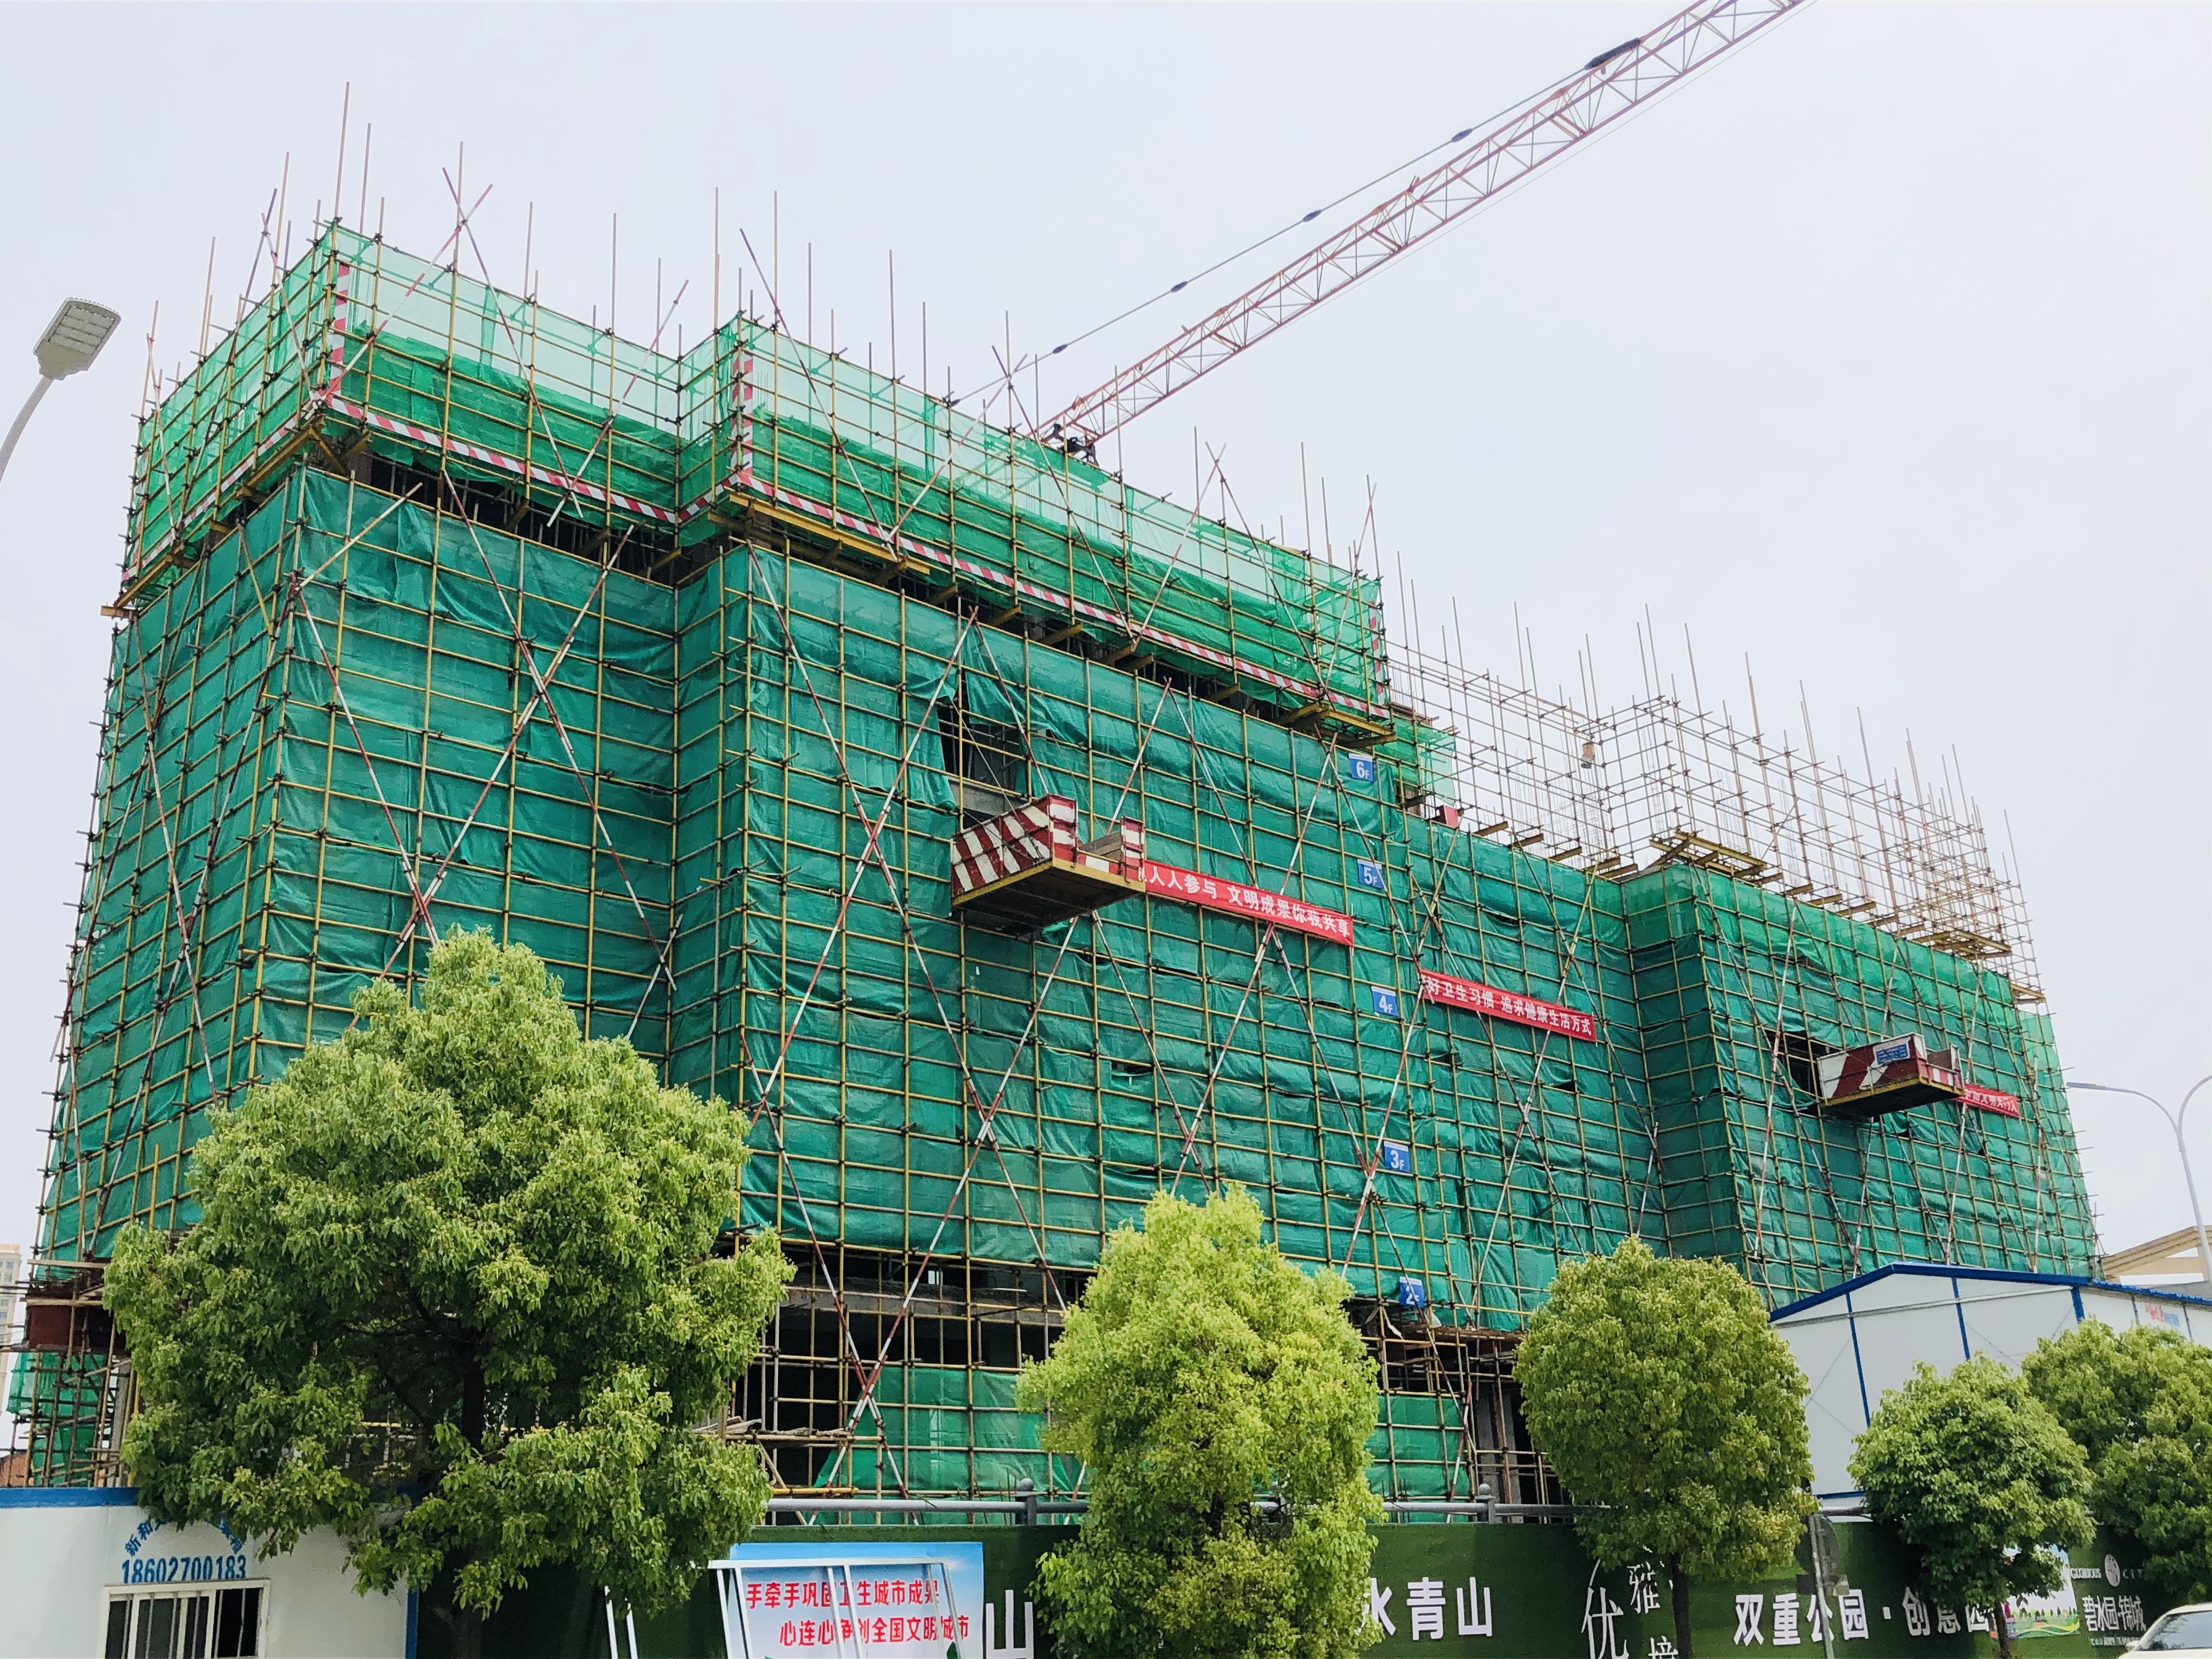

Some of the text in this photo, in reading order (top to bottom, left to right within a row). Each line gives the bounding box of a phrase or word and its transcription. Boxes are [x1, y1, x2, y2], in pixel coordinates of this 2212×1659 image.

[1356, 761, 1370, 779] 6F
[1363, 866, 1378, 885] 5F
[1144, 865, 1350, 938] 人人参与 文明成果你我共享
[1379, 995, 1393, 1013] 4F
[1501, 995, 1591, 1035] 追求健康生活方式
[1390, 1150, 1404, 1170] 3F
[122, 1554, 246, 1584] 18602700183
